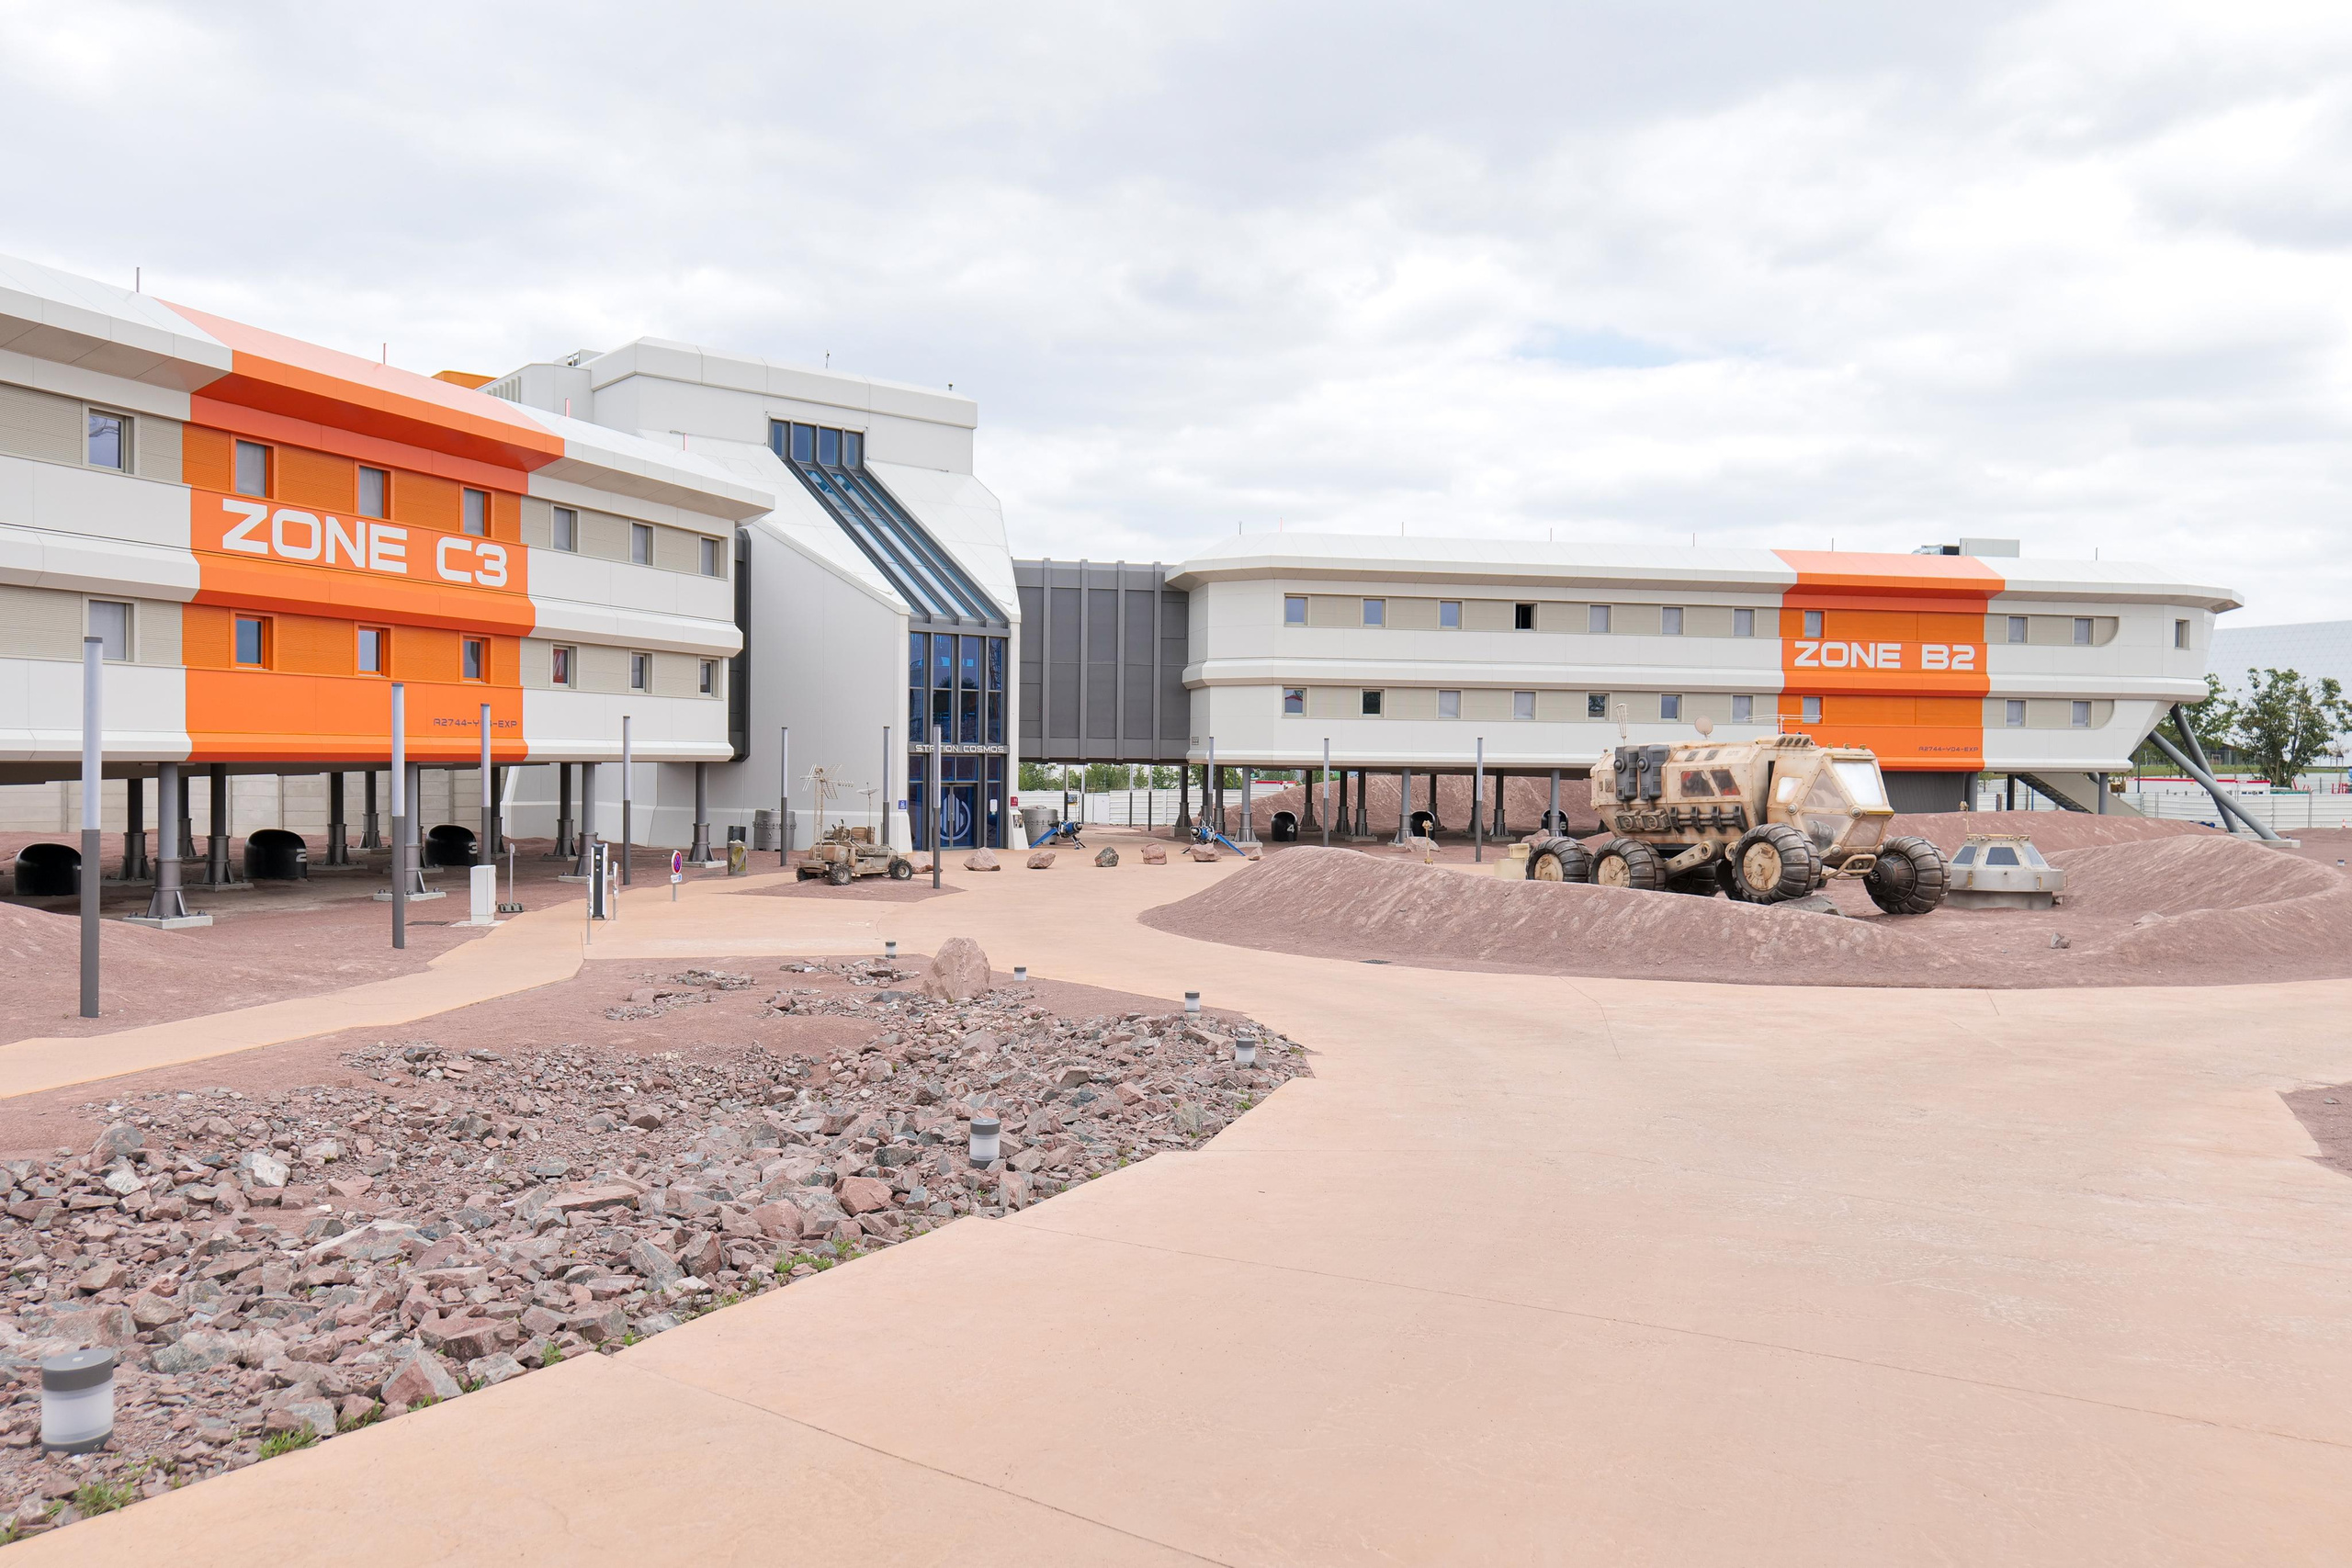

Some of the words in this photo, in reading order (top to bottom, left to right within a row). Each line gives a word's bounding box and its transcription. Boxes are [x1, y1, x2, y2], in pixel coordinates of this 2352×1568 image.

[222, 498, 408, 574] ZONE
[436, 536, 508, 588] C3
[1794, 641, 1901, 669] ZONE
[1921, 644, 1975, 671] B2
[433, 718, 517, 728] A2744-Y-EXP
[963, 745, 1004, 753] COSMOS
[1286, 824, 1295, 833] 4
[1559, 821, 1567, 830] 6
[468, 841, 478, 854] 3
[296, 848, 308, 863] 2
